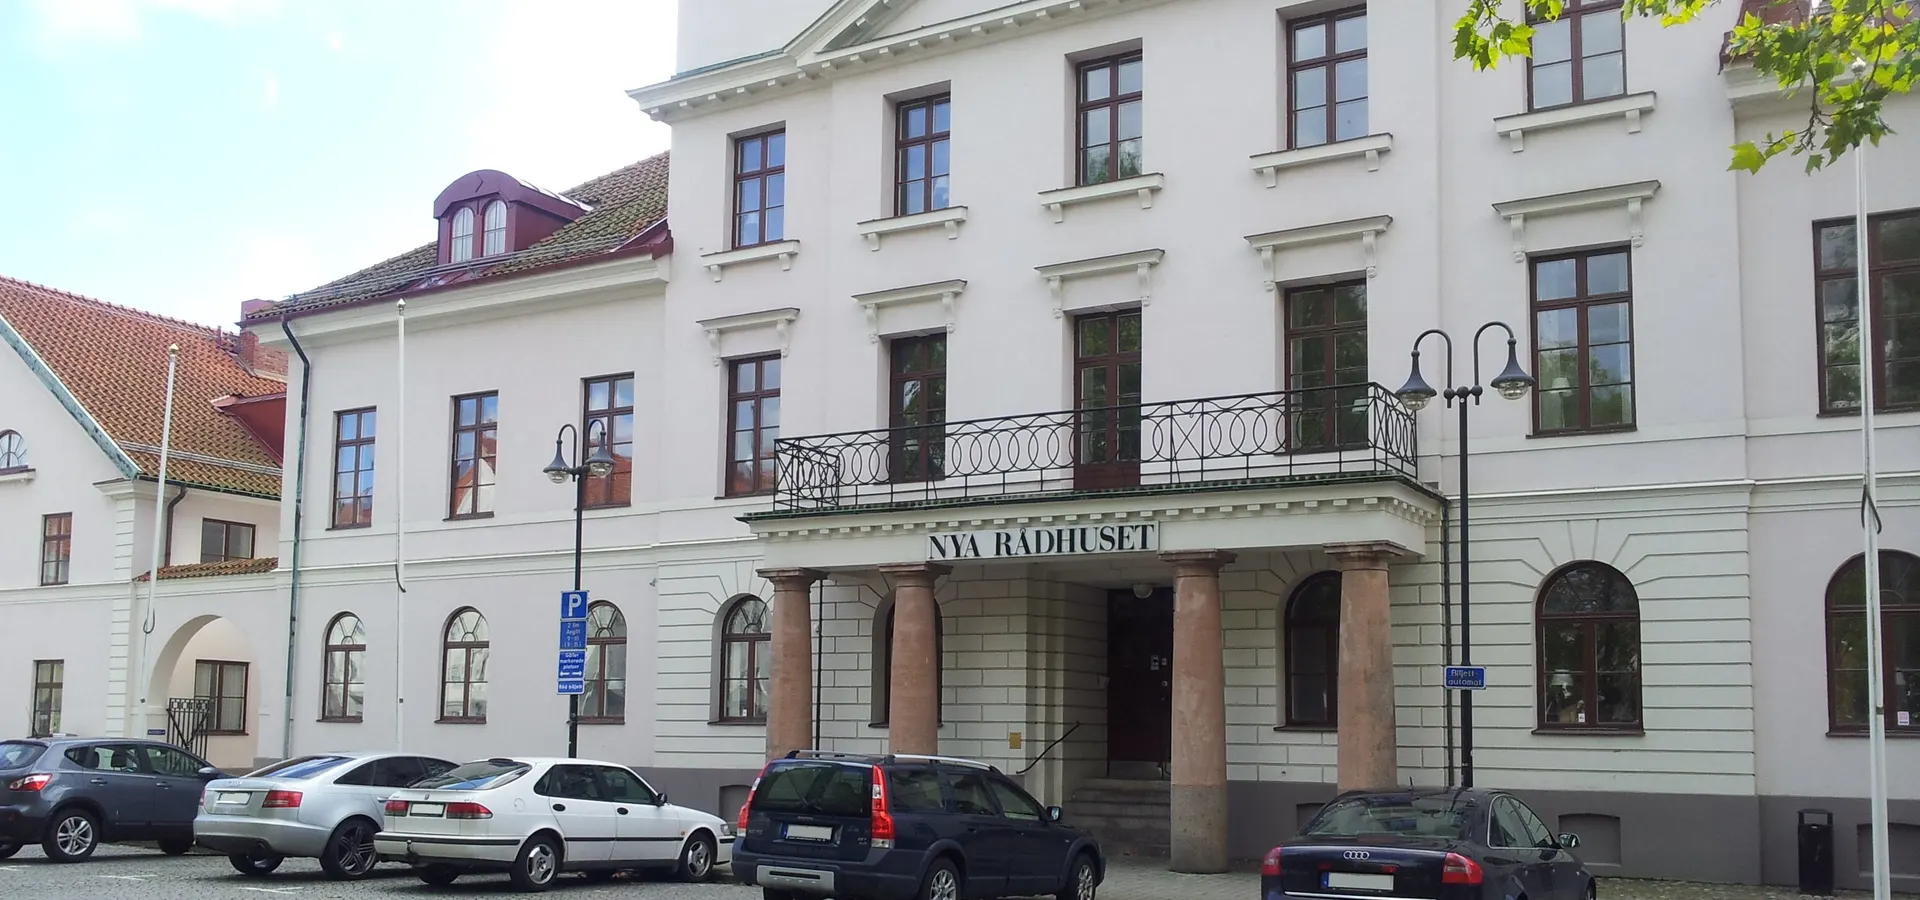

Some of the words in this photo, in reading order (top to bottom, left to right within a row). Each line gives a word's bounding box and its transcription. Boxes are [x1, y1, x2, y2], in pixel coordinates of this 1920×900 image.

[928, 533, 982, 559] NYA
[994, 524, 1155, 556] RÅDHUSET
[568, 593, 582, 617] P
